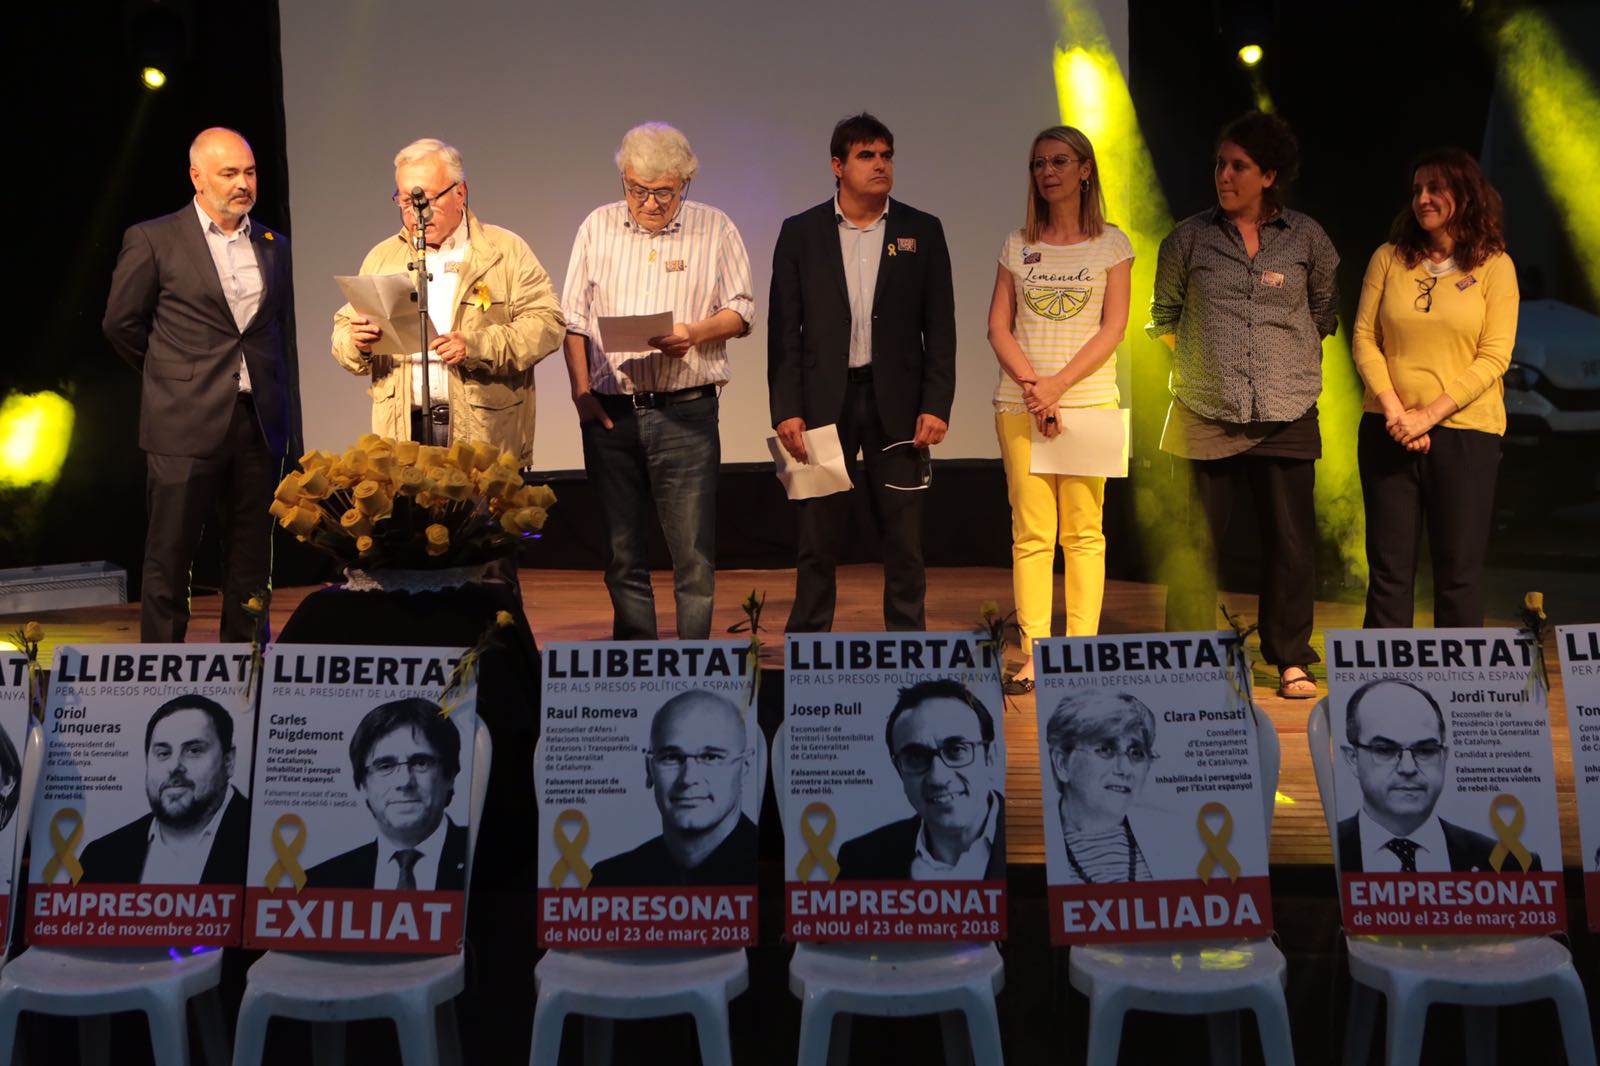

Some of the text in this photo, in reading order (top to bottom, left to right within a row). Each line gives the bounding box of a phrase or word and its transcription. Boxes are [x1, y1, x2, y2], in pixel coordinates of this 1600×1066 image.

[1023, 266, 1094, 283] Lemonade
[790, 639, 994, 670] LLIBERTAT
[1041, 638, 1242, 674] LLIBERTAT
[1334, 639, 1535, 667] LLIBERTAT
[58, 654, 252, 682] LLIBERTAT
[548, 647, 751, 678] LLIBERTAT
[790, 674, 810, 685] PER
[815, 674, 834, 684] ALS
[838, 674, 880, 684] PRESOS
[884, 672, 932, 684] POLÍTICS
[1044, 678, 1065, 688] PER
[1101, 675, 1151, 687] DEFENSA
[1154, 674, 1168, 684] LA
[1335, 672, 1355, 682] PER
[1359, 672, 1378, 681] ALS
[1427, 670, 1474, 681] POLÍTICS
[1479, 671, 1486, 681] A
[55, 686, 75, 697] PER
[78, 686, 97, 697] ALS
[100, 686, 140, 697] PRESOS
[143, 684, 189, 697] POLÍTICS
[272, 687, 291, 696] PER
[294, 687, 306, 697] AL
[309, 688, 364, 698] PRESIDENT
[368, 689, 379, 698] DE
[384, 689, 396, 698] LA
[547, 682, 567, 693] PER
[571, 682, 591, 693] ALS
[594, 681, 636, 692] PRESOS
[640, 679, 687, 692] POLÍTICS
[1450, 690, 1485, 702] Jordi
[54, 707, 86, 720] Oriol
[547, 707, 638, 719] Raul Romeva
[790, 703, 862, 718] Josep Rull
[1164, 707, 1246, 722] Clara Ponsatí
[270, 714, 307, 725] Carles
[1500, 720, 1533, 728] portaveu
[51, 722, 121, 735] Junqueras
[269, 728, 344, 742] Puigdemont
[1206, 729, 1247, 737] Consellera
[1453, 729, 1478, 737] govern
[1498, 728, 1540, 736] Generalitat
[268, 747, 317, 756] Triat pel poble
[1185, 750, 1194, 758] de
[1204, 748, 1248, 757] Generalitat
[308, 767, 341, 775] perseguit
[1155, 775, 1203, 783] Inhabilitada
[1208, 773, 1252, 783] perseguida
[265, 775, 277, 783] per
[1176, 785, 1189, 793] per
[1350, 880, 1557, 906] EMPRESONAT
[34, 892, 236, 918] EMPRESONAT
[543, 895, 753, 922] EMPRESONAT
[791, 889, 1002, 915] EMPRESONAT
[1062, 893, 1262, 933] EXILIADA
[1353, 910, 1557, 928] de NOU el 23 de març 2018
[255, 900, 452, 941] EXILIAT
[34, 921, 230, 936] des del 2 de novembre 2017
[544, 927, 750, 944] de NOU el 23 de març 2018
[792, 920, 999, 938] de NOU el 23 de març 2018
